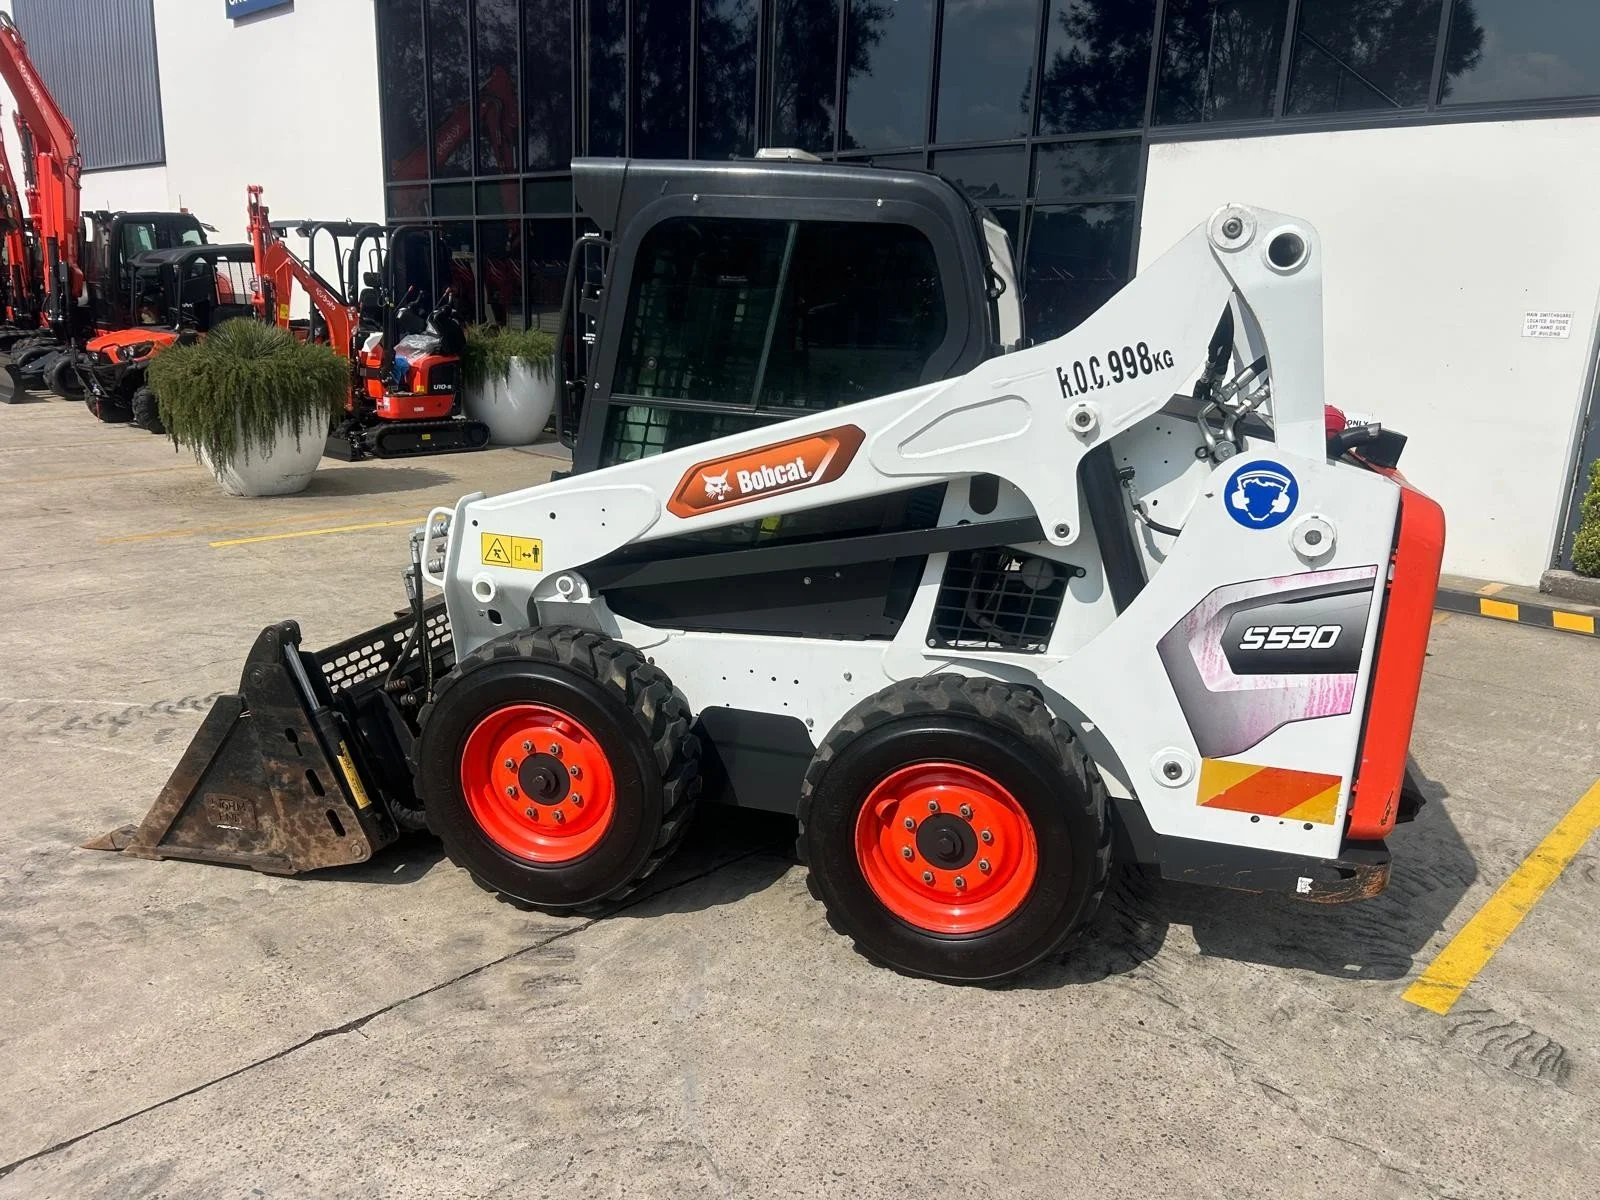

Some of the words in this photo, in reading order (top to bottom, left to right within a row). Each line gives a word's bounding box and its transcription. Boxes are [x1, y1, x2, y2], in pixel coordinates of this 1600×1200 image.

[18, 60, 41, 103] Kubota
[315, 287, 336, 311] Kubota
[1345, 419, 1369, 427] ONLY
[736, 456, 808, 494] Bobcat
[1240, 625, 1343, 650] S590
